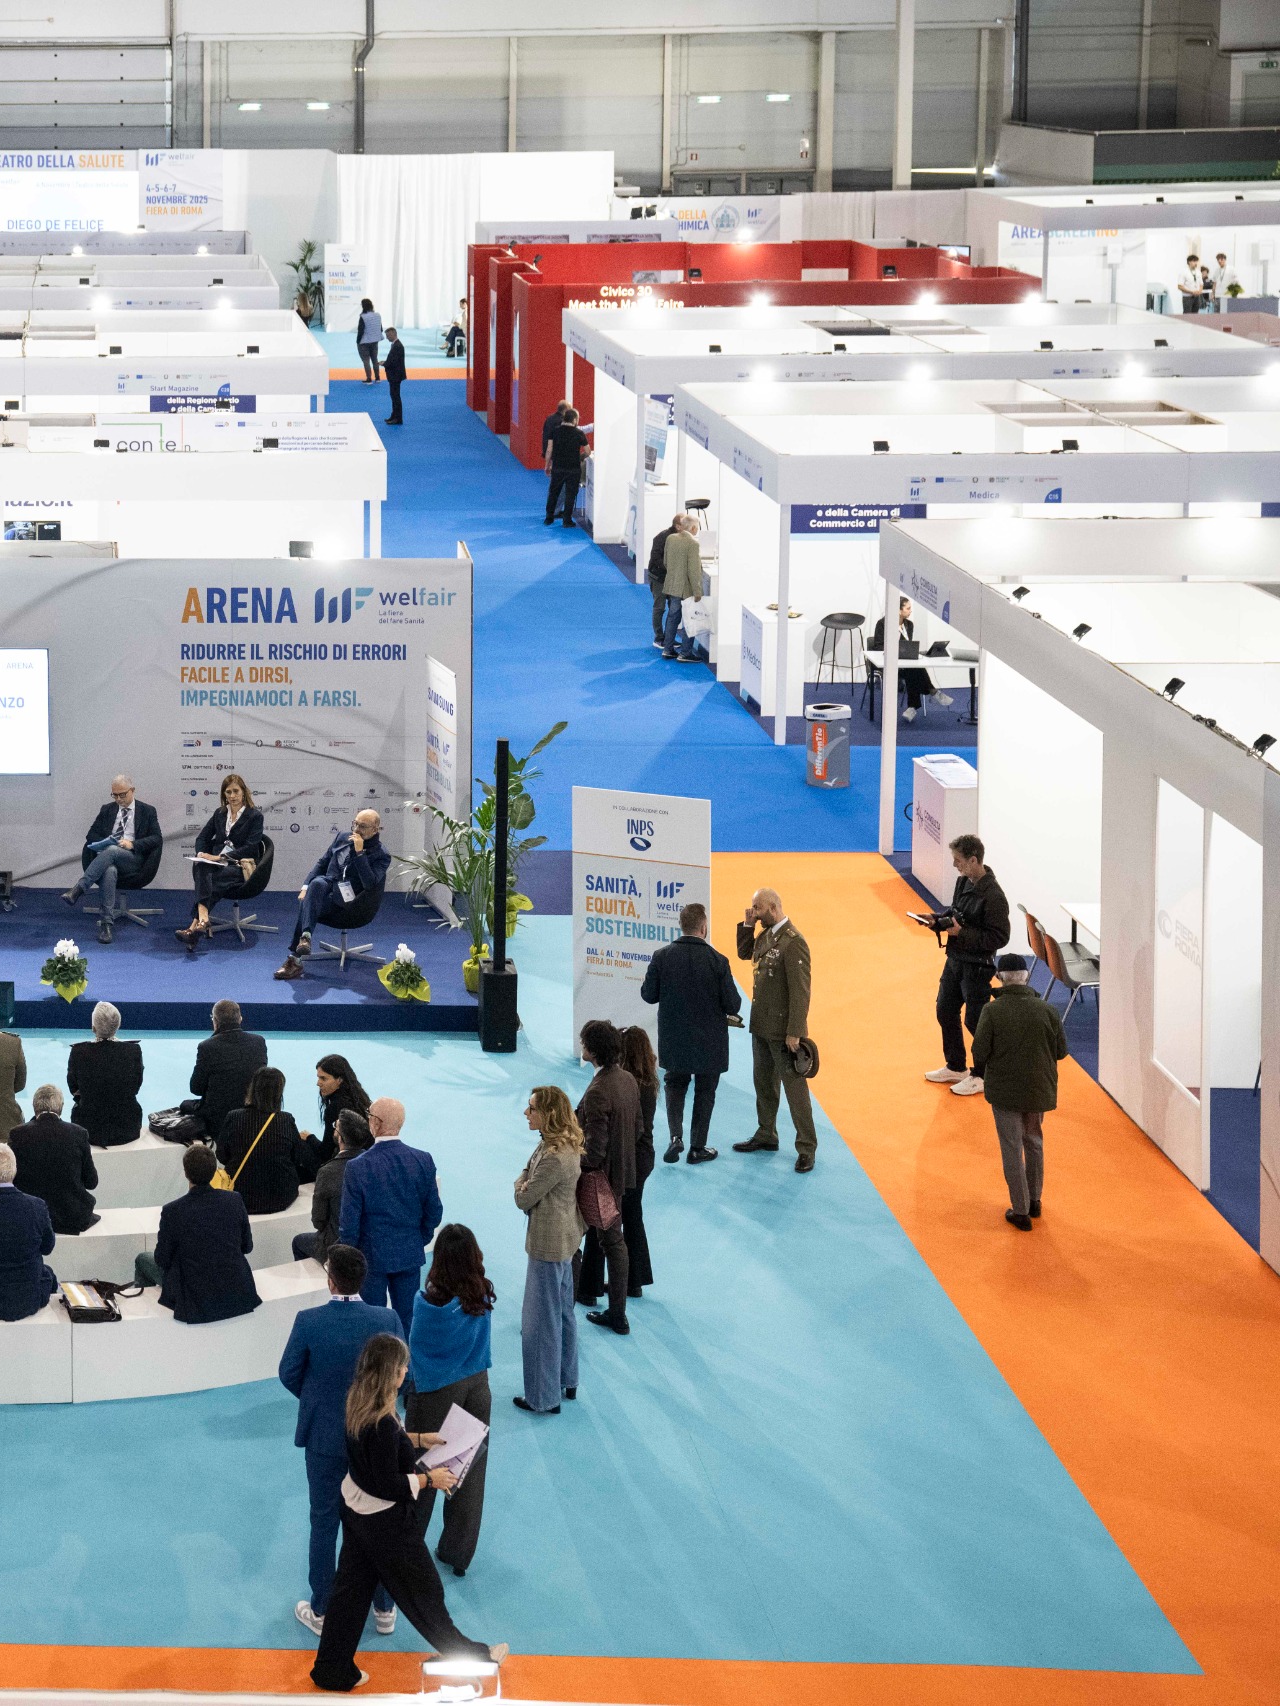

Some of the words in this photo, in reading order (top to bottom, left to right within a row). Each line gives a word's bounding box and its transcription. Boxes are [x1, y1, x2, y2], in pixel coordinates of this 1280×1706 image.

[37, 154, 75, 168] DELLA
[78, 154, 125, 168] SALUTE
[146, 184, 176, 192] 4-5-6-7
[146, 195, 187, 204] NOVEMBRE
[189, 195, 208, 204] 2025
[146, 206, 168, 215] FIERA
[170, 206, 178, 215] DI
[180, 206, 203, 215] ROMA
[677, 209, 707, 219] DELLA
[7, 219, 42, 230] DIEGO
[45, 219, 61, 230] DE
[64, 219, 104, 230] FELICE
[678, 220, 710, 230] HIMICA
[600, 286, 635, 297] Civico
[568, 299, 597, 309] Meet
[599, 299, 619, 309] the
[168, 385, 199, 393] Magazine
[187, 397, 217, 405] Regione
[117, 440, 153, 452] con
[159, 438, 177, 452] te
[969, 490, 1000, 499] Medica
[816, 509, 823, 517] e
[824, 507, 851, 517] della
[852, 507, 889, 517] Camera
[890, 506, 900, 517] di
[809, 519, 864, 528] Commercio
[866, 518, 877, 528] di
[181, 587, 298, 624] ARENA
[378, 587, 457, 606] welfair
[404, 617, 425, 625] Sanità
[180, 643, 246, 661] RIDURRE
[250, 643, 264, 661] IL
[268, 643, 328, 661] RISCHIO
[332, 643, 348, 661] DI
[352, 643, 407, 661] ERRORI
[6, 662, 34, 670] ARENA
[180, 666, 230, 684] FACILE
[234, 666, 245, 683] A
[249, 666, 293, 686] DIRSI,
[180, 689, 293, 707] IMPEGNIAMOCI
[297, 689, 308, 707] A
[313, 689, 362, 707] FARSI.
[427, 686, 454, 717] SAMSUNG
[627, 818, 654, 837] INPS
[586, 874, 642, 898] SANITÀ,
[586, 896, 640, 919] EQUITÀ,
[656, 902, 684, 912] welfa
[586, 916, 682, 943] SOSTENIBILIT
[1175, 919, 1200, 953] FIERA
[586, 947, 599, 956] DAL
[606, 949, 614, 957] AL
[621, 951, 652, 962] NOVEMBR
[1175, 935, 1202, 971] ROMA
[586, 956, 605, 965] FIERA
[606, 958, 613, 966] DI
[614, 959, 632, 969] ROMA
